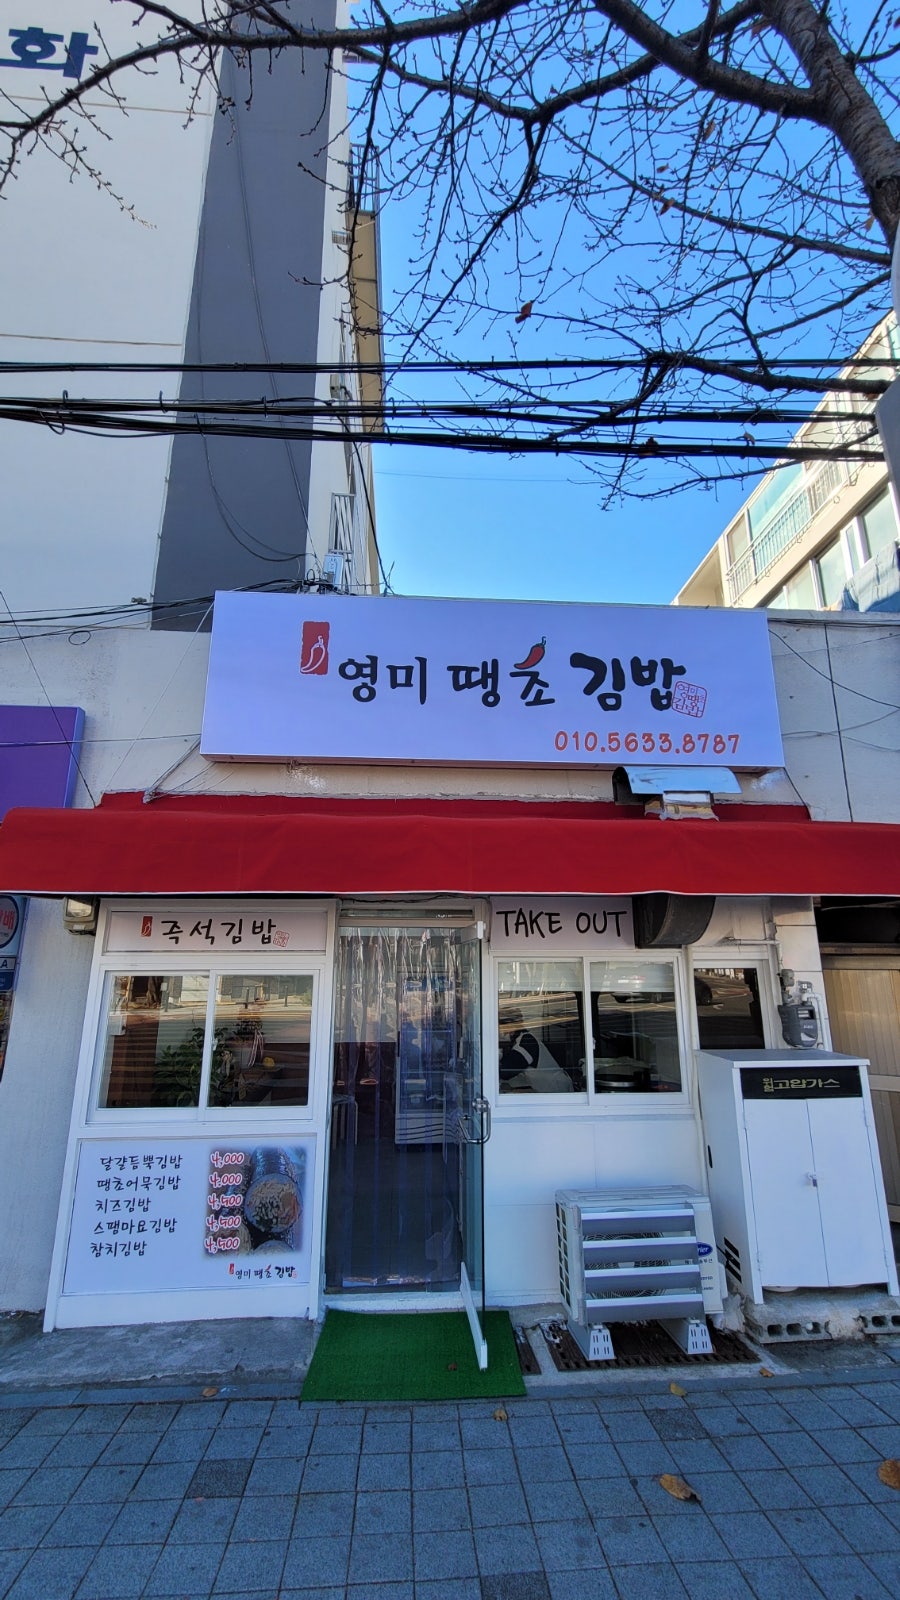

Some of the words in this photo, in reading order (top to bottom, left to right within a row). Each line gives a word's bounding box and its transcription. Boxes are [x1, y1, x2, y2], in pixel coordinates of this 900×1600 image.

[338, 655, 427, 705] 영미
[446, 639, 556, 708] 땡초
[570, 652, 687, 711] 김밥
[554, 731, 740, 755] 010.5633.8787
[160, 918, 277, 945] 즉석김밥
[496, 907, 563, 939] TAKE
[575, 910, 628, 937] OUT
[774, 1078, 841, 1090] 고압가스
[212, 1152, 244, 1168] 4,000
[97, 1175, 181, 1191] 땡초어묵김밥
[210, 1172, 242, 1188] 4,000
[95, 1197, 151, 1214] 치즈김밥
[208, 1193, 242, 1210] 4,500
[94, 1218, 177, 1235] 스팸마요김밥
[207, 1215, 240, 1231] 4,500
[90, 1241, 147, 1258] 참치김밥
[205, 1236, 239, 1253] 4,500
[235, 1268, 251, 1280] 영미
[254, 1265, 272, 1279] 땡초
[274, 1265, 296, 1279] 김밥
